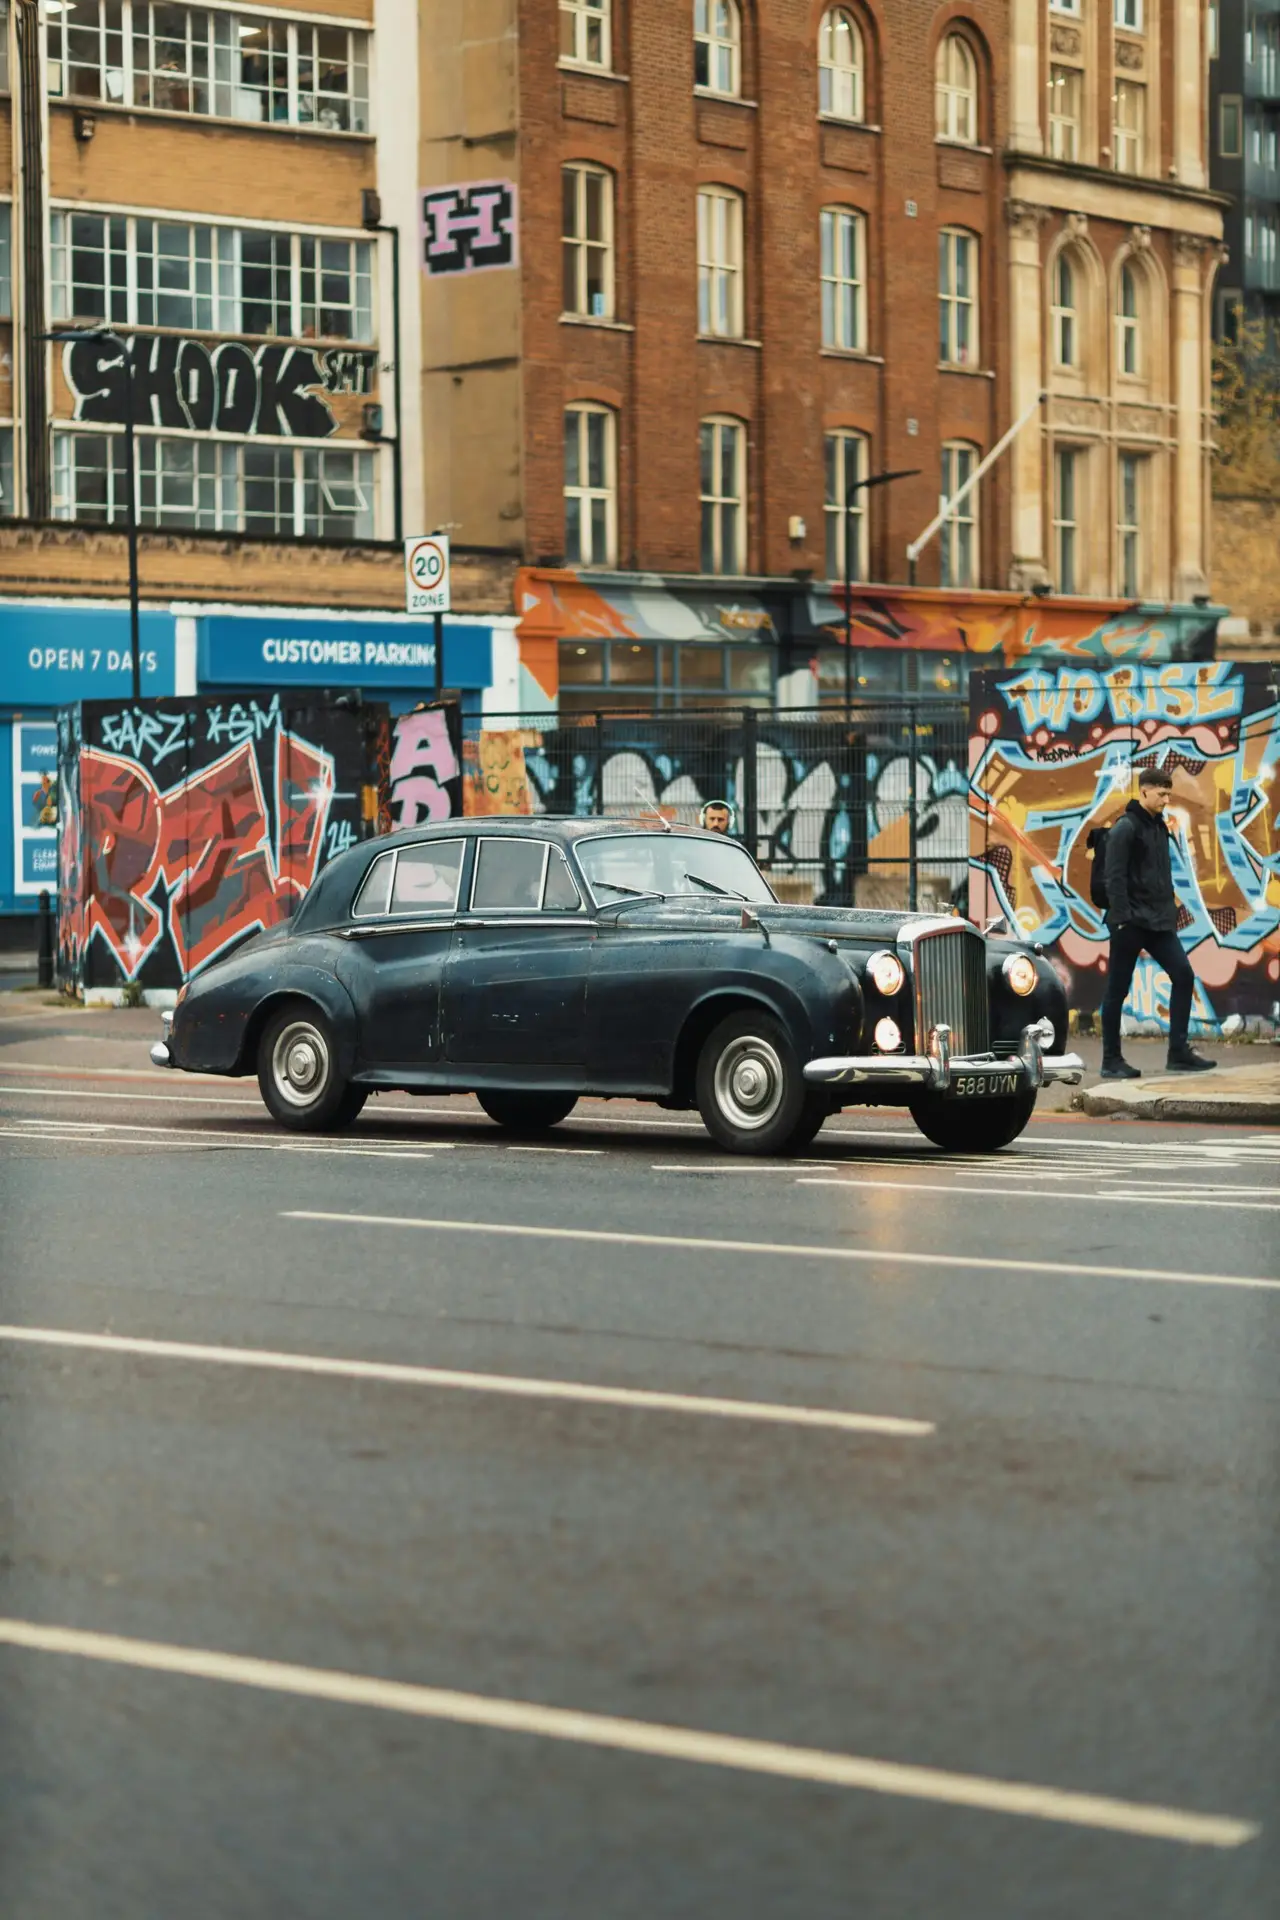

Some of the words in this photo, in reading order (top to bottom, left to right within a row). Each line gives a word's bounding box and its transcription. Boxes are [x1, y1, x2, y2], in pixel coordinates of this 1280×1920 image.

[422, 184, 514, 275] H
[415, 556, 440, 576] 20
[412, 593, 444, 607] ZONE
[28, 648, 84, 670] OPEN
[91, 650, 101, 671] 7
[262, 638, 362, 665] CUSTOMER
[1001, 668, 1100, 730] TWO
[1104, 662, 1242, 723] RISE
[956, 1077, 985, 1095] 588
[989, 1075, 1018, 1093] UYN
